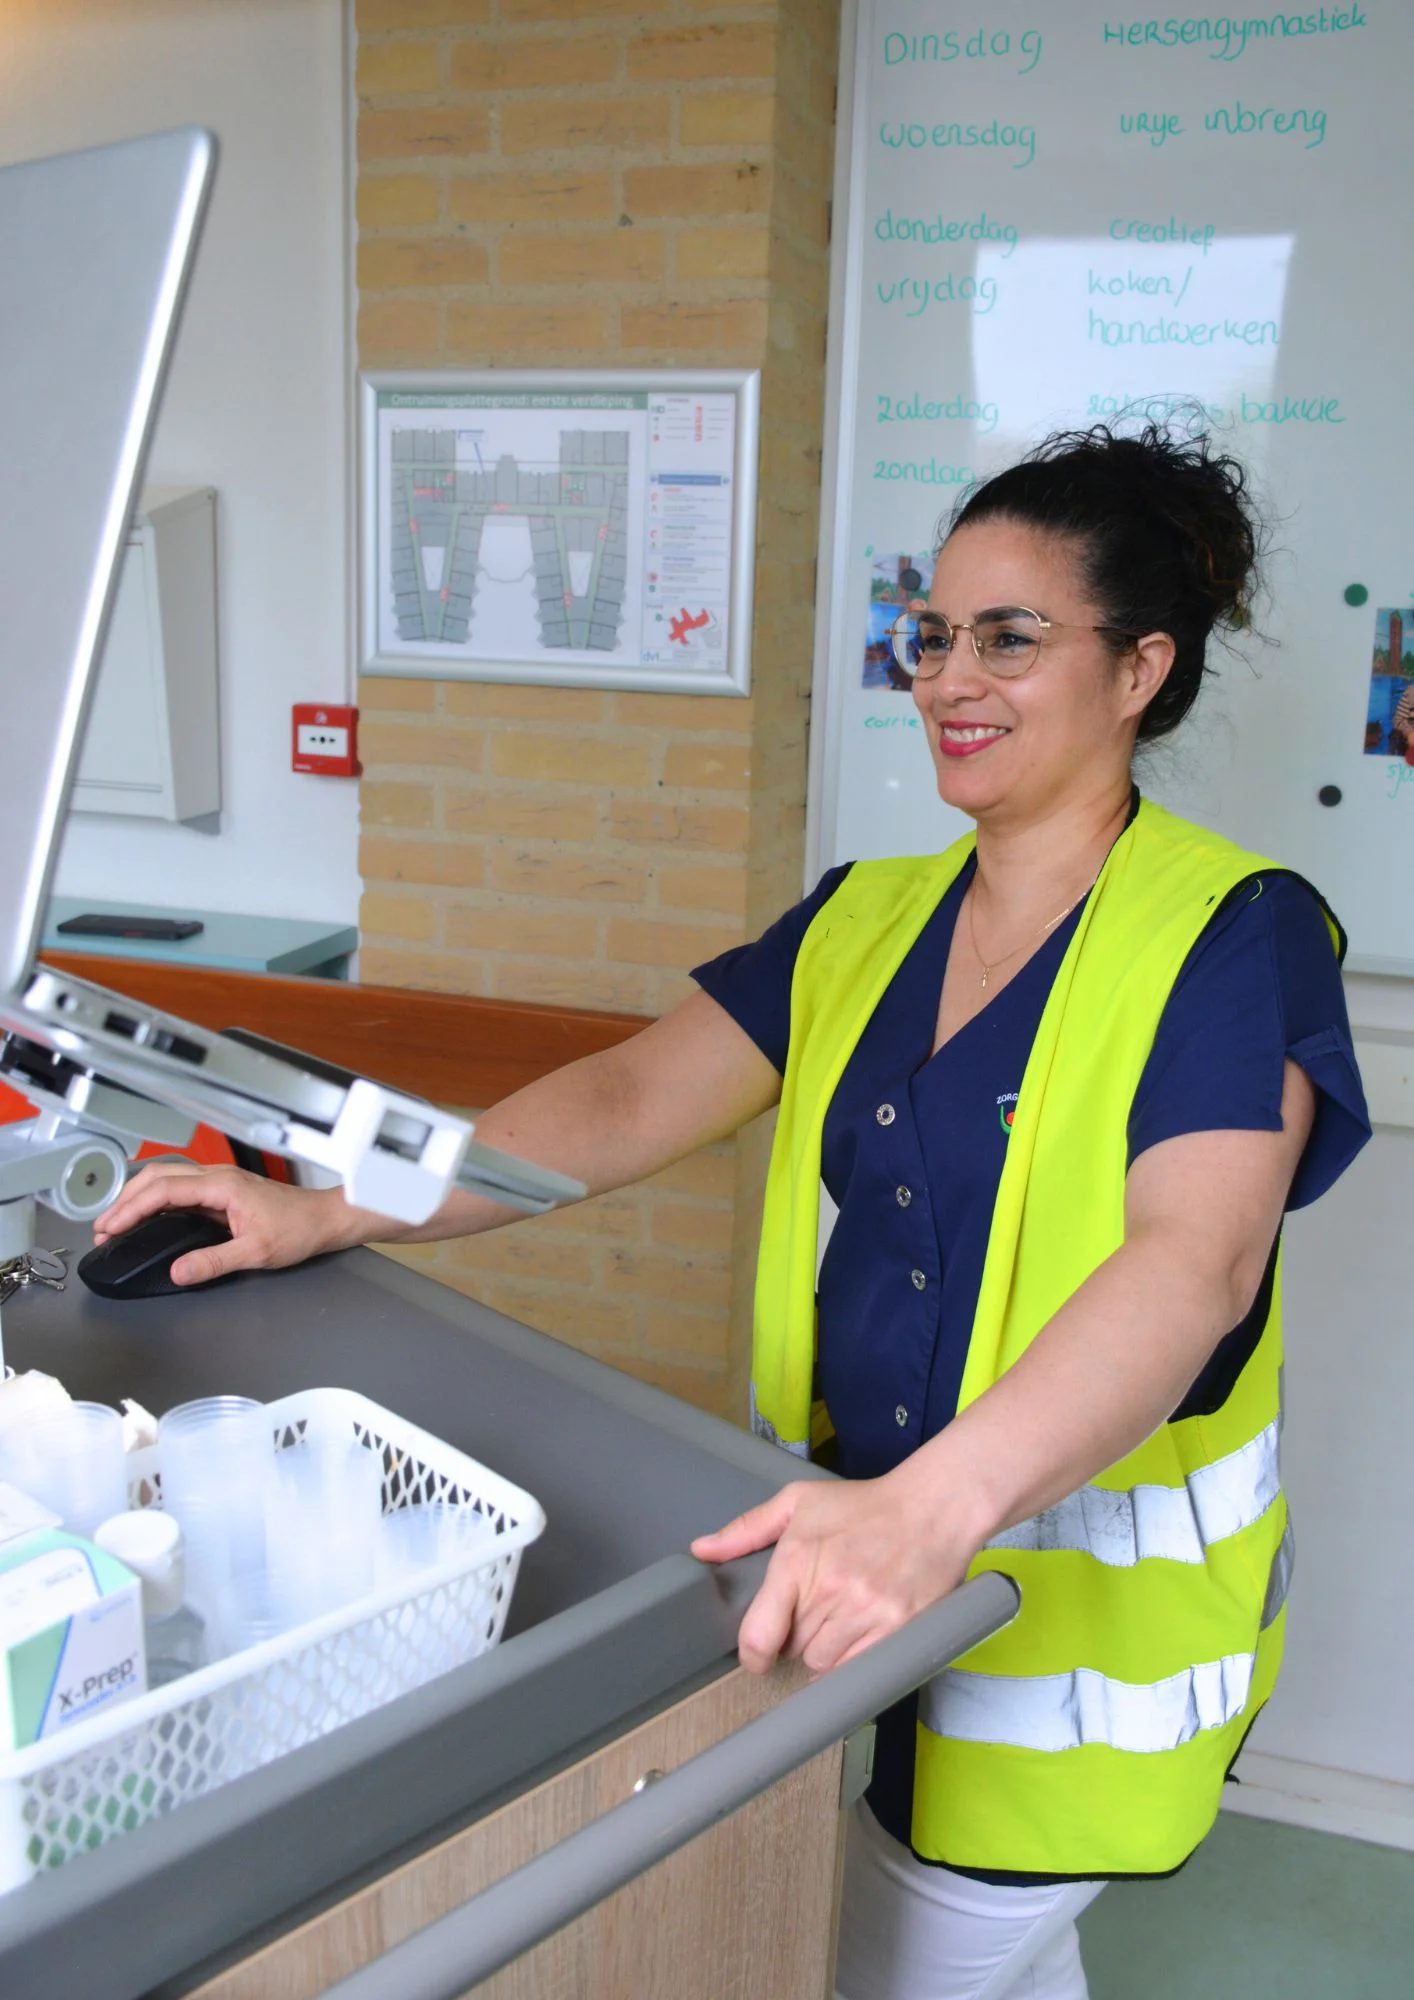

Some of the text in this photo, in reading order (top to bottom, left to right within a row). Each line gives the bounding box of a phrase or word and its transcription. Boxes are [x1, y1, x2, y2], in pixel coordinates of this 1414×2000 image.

[883, 27, 1043, 75] Dinsdag
[874, 208, 1018, 259] donderdag
[1108, 215, 1216, 257] creatief
[1087, 306, 1280, 347] handwerken
[532, 396, 569, 407] eerste
[571, 394, 635, 409] verdieping
[1241, 393, 1345, 424] bakkie
